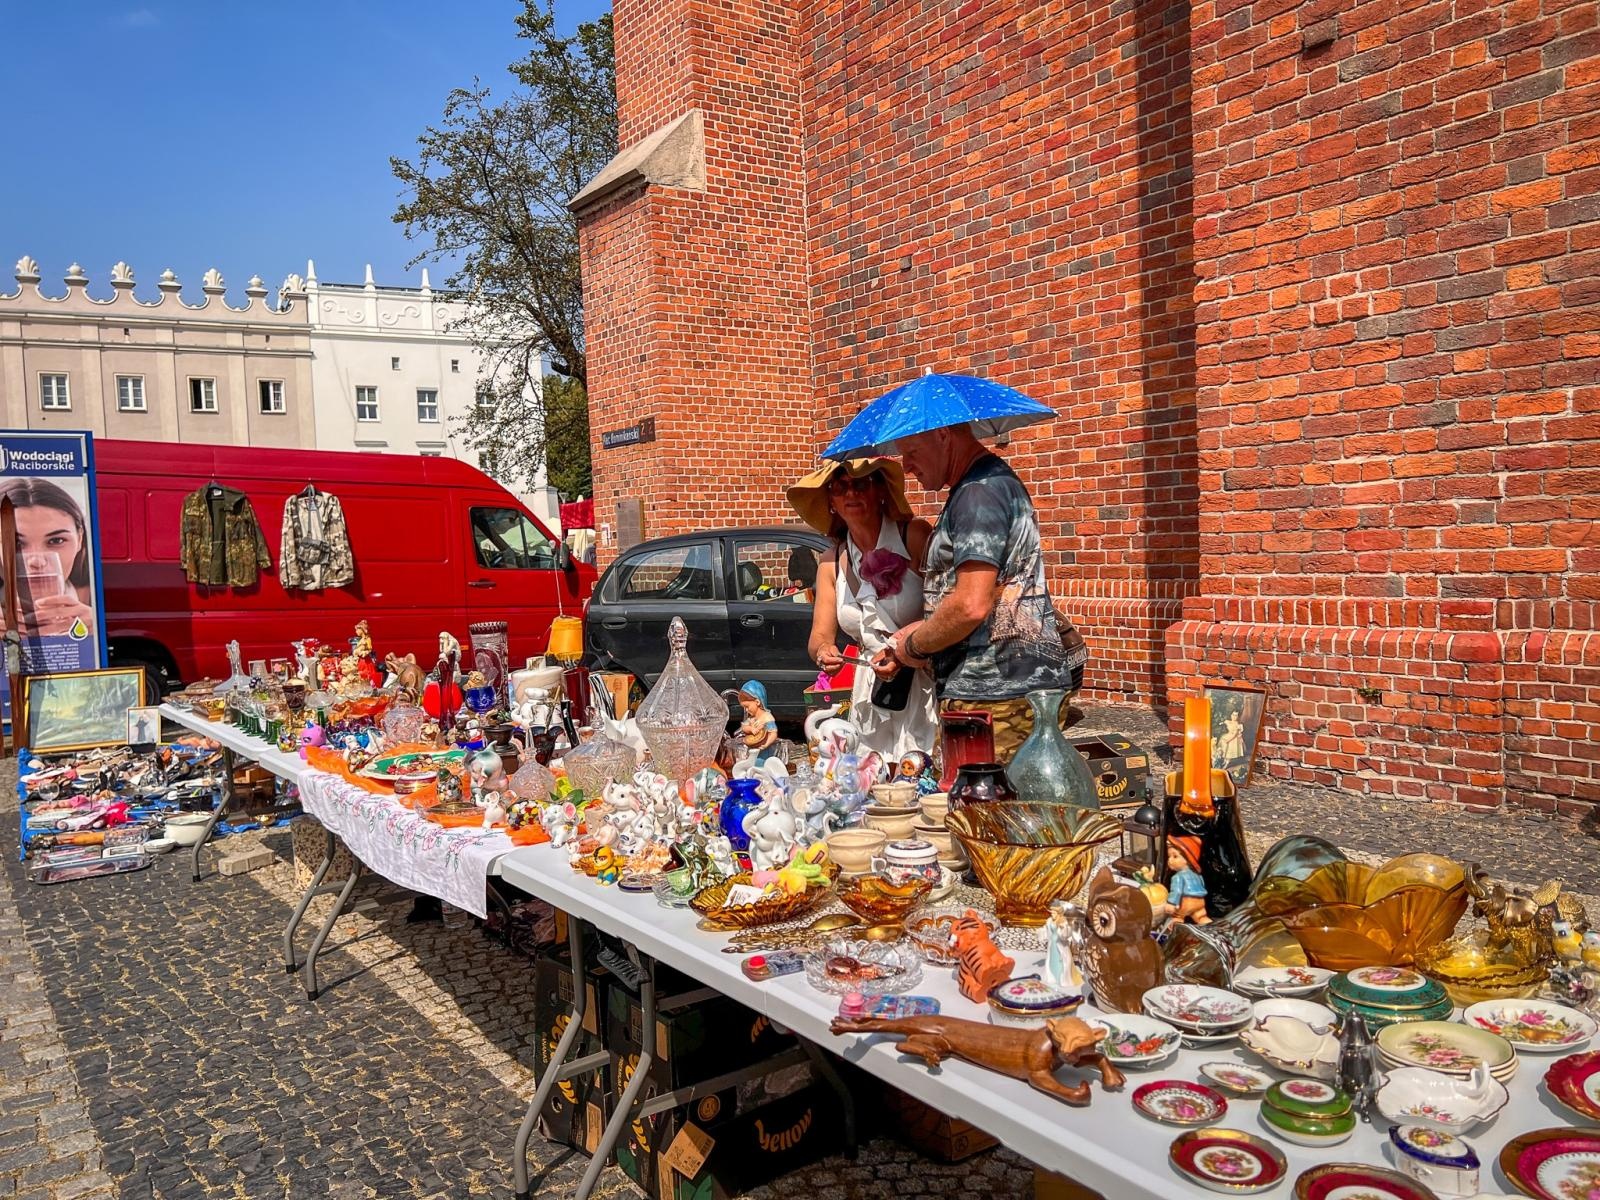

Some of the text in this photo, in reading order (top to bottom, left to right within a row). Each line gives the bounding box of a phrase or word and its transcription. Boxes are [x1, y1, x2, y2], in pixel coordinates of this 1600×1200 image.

[9, 451, 74, 463] Wodociągi
[11, 461, 75, 470] Raciborskie
[754, 1107, 813, 1152] yellow
